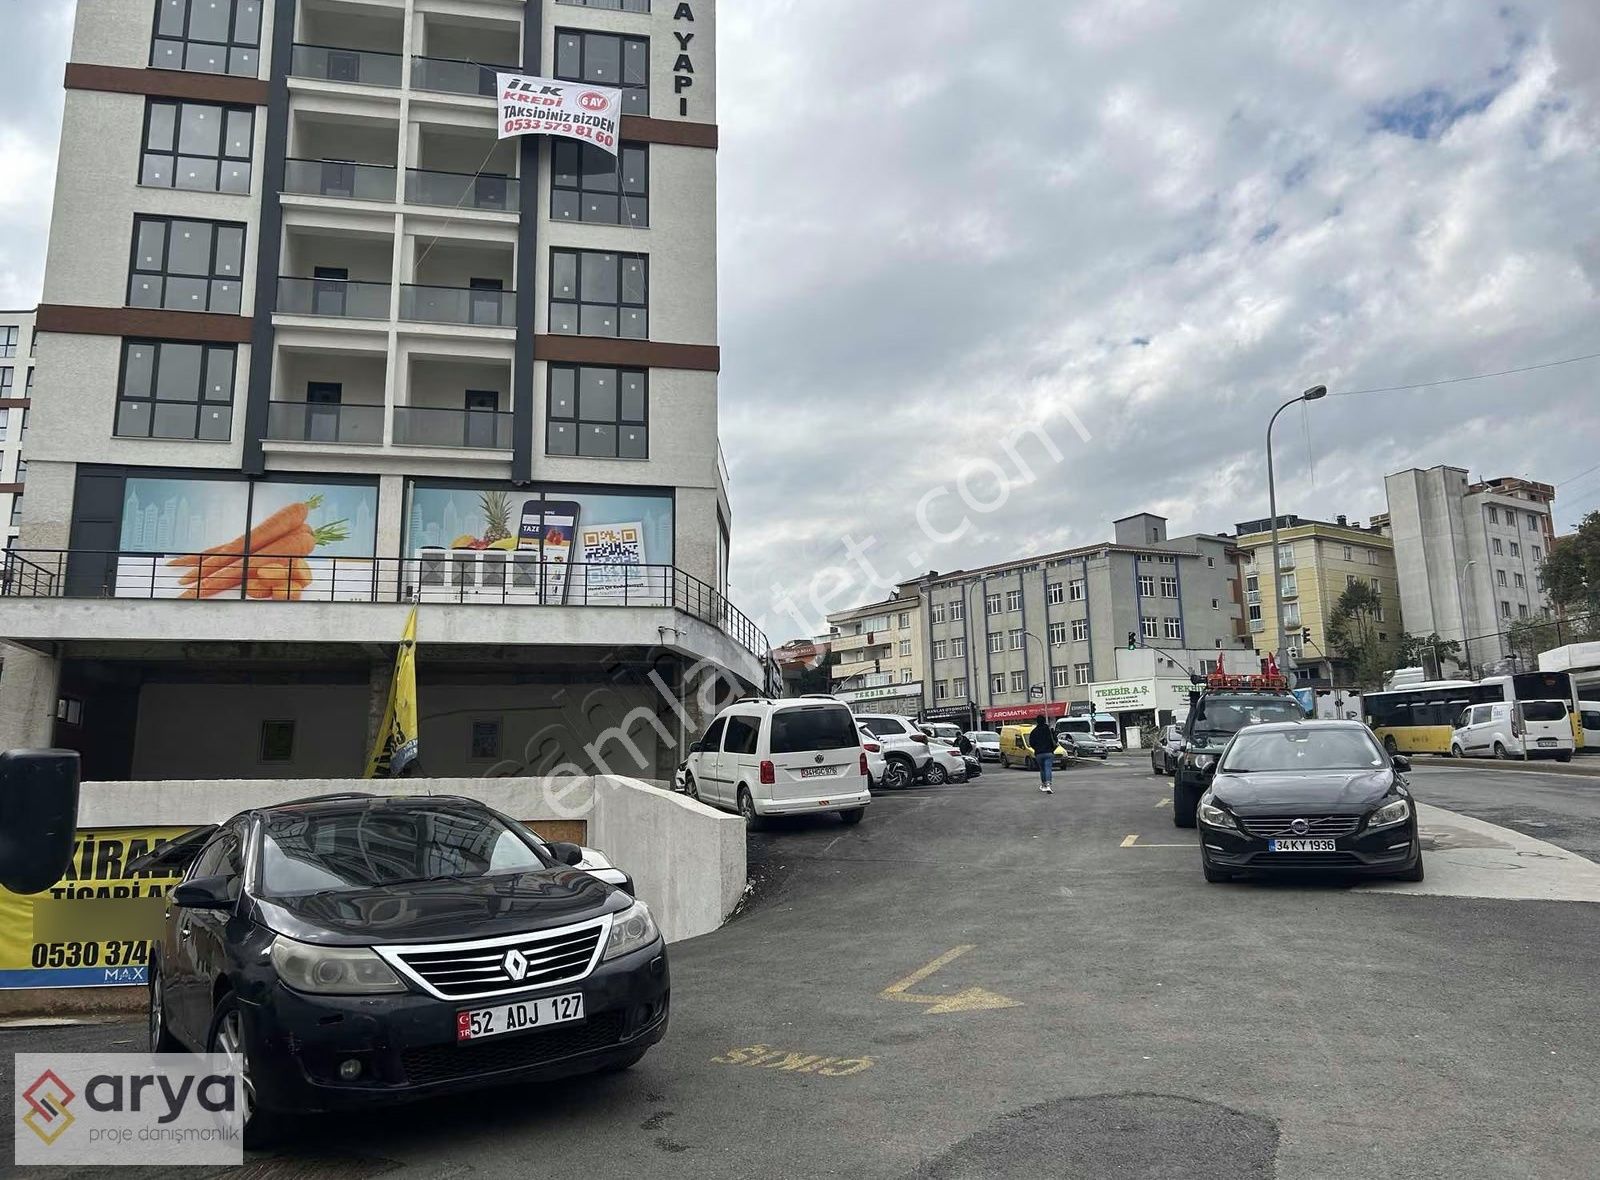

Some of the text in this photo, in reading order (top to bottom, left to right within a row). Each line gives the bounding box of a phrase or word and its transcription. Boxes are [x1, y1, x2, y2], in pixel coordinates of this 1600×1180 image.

[506, 78, 564, 97] İLK
[503, 91, 563, 108] KREDİ
[589, 97, 603, 108] AY
[503, 105, 615, 134] TAKSİDİNİZ BİZDEN
[504, 118, 614, 147] 0533 579 81 60
[522, 525, 540, 533] TAZE
[1096, 687, 1131, 697] TEKBİR
[1277, 840, 1334, 850] 34 KY 1936
[31, 940, 148, 968] 0530 374
[470, 995, 581, 1035] 52 ADJ 127
